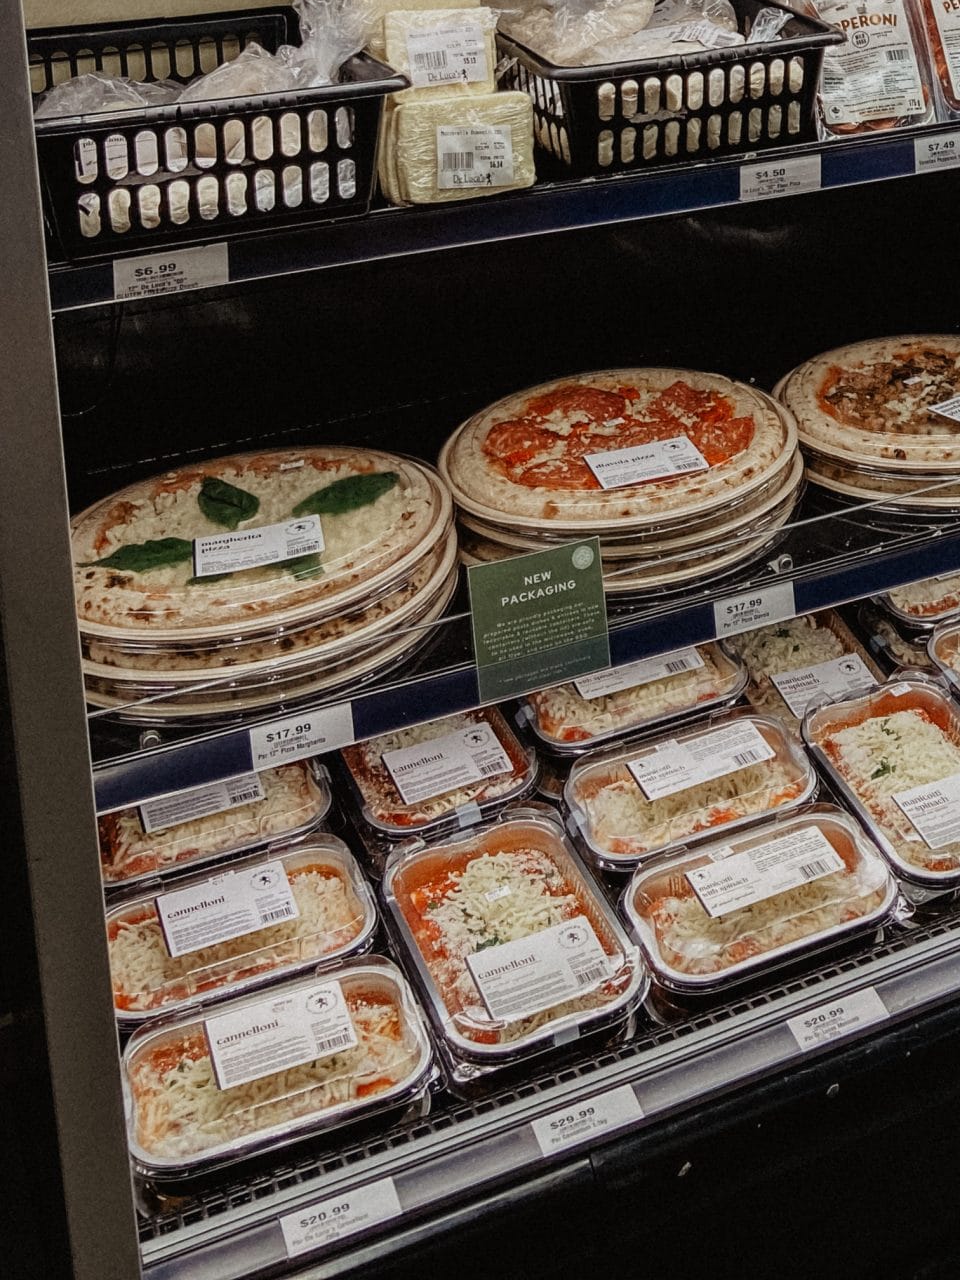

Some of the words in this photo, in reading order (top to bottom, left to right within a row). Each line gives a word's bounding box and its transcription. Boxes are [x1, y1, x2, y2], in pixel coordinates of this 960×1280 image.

[928, 141, 954, 152] $7.49
[453, 174, 462, 184] De
[464, 173, 486, 183] Luca's
[756, 168, 786, 179] $4.50
[135, 264, 176, 277] $6.99
[632, 452, 656, 463] pizza
[200, 532, 262, 548] margherita
[200, 542, 230, 554] pizza
[524, 570, 552, 586] NEW
[501, 580, 576, 607] PACKAGING
[726, 598, 762, 615] $17.99
[776, 673, 816, 687] manicotti
[790, 678, 820, 692] spinach
[266, 723, 312, 743] $17.99
[392, 752, 444, 774] cannelloni
[900, 790, 942, 808] manicotti
[914, 795, 949, 814] spinach
[167, 896, 226, 920] cannelloni
[478, 954, 536, 980] cannelloni
[804, 1007, 844, 1028] $20.99
[216, 1020, 280, 1046] cannelloni
[550, 1108, 596, 1130] $29.99
[300, 1204, 351, 1228] $20.99
